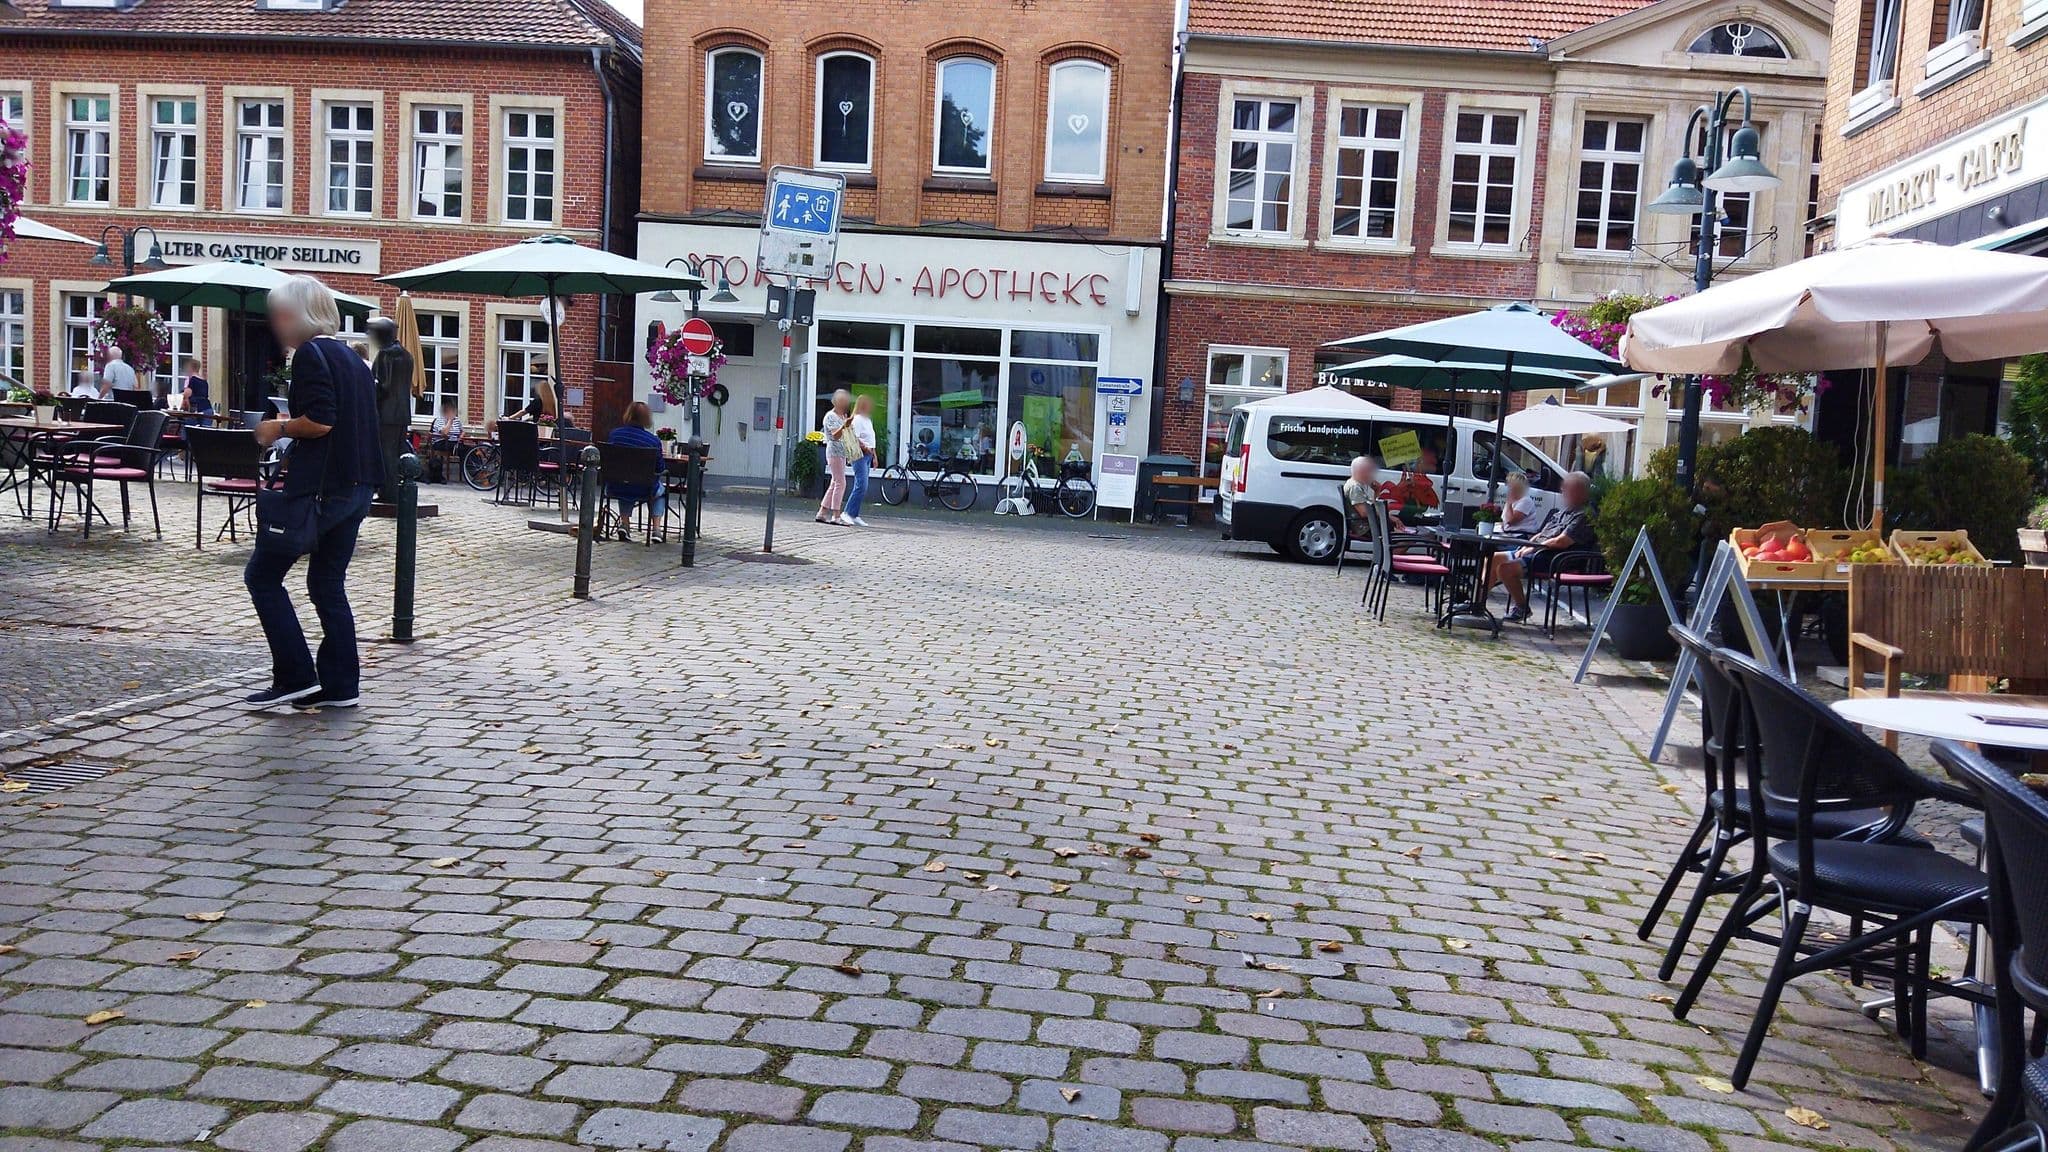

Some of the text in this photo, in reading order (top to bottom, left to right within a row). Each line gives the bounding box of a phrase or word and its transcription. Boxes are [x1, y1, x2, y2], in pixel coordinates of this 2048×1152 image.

[1868, 164, 1940, 227] MARKT
[1957, 116, 2028, 191] CAFÉ
[162, 241, 361, 264] LTER GASTHOF SEILING
[688, 252, 885, 294] STOEN
[912, 265, 1109, 306] APOTHEKE
[1280, 423, 1359, 436] Frische Landprodukte
